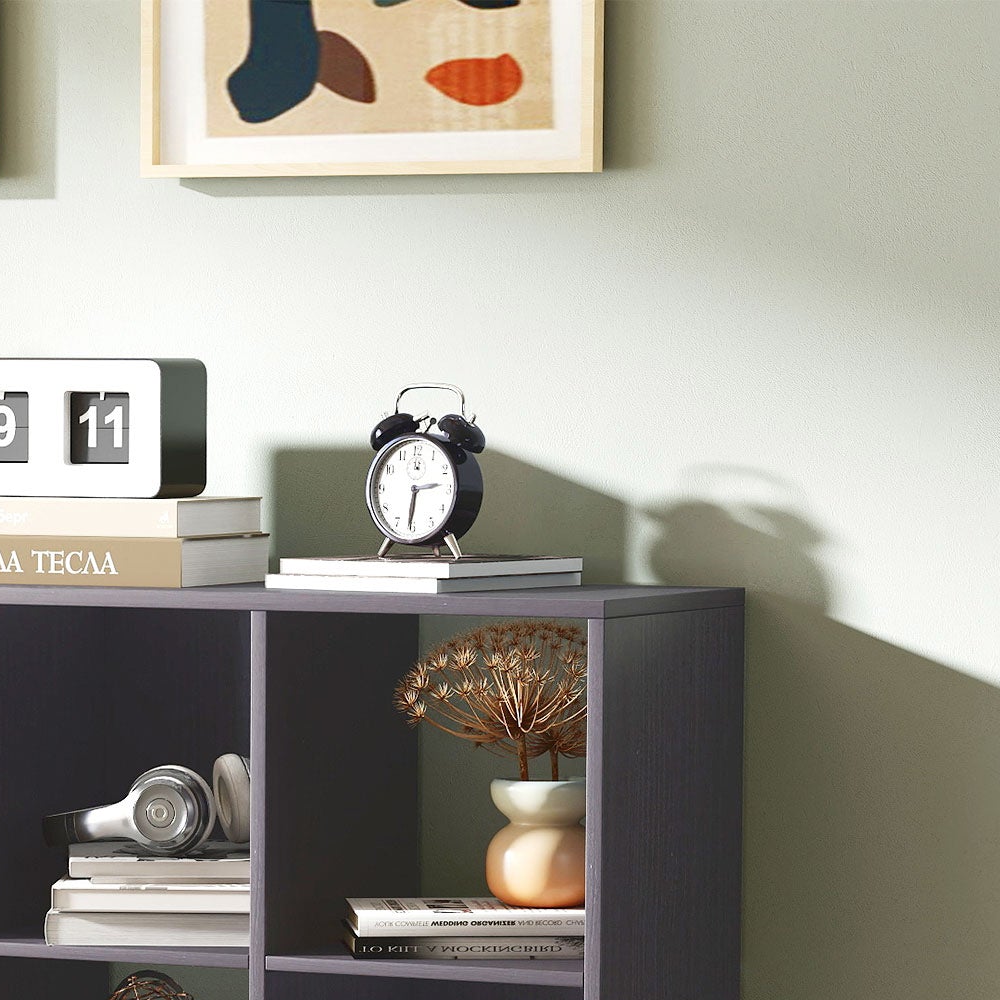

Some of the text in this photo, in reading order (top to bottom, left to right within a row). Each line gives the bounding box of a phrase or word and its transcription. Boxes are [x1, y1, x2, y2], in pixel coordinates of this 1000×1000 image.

[78, 405, 124, 449] 11
[413, 445, 423, 457] 12
[31, 551, 118, 576] ТЕСЛА
